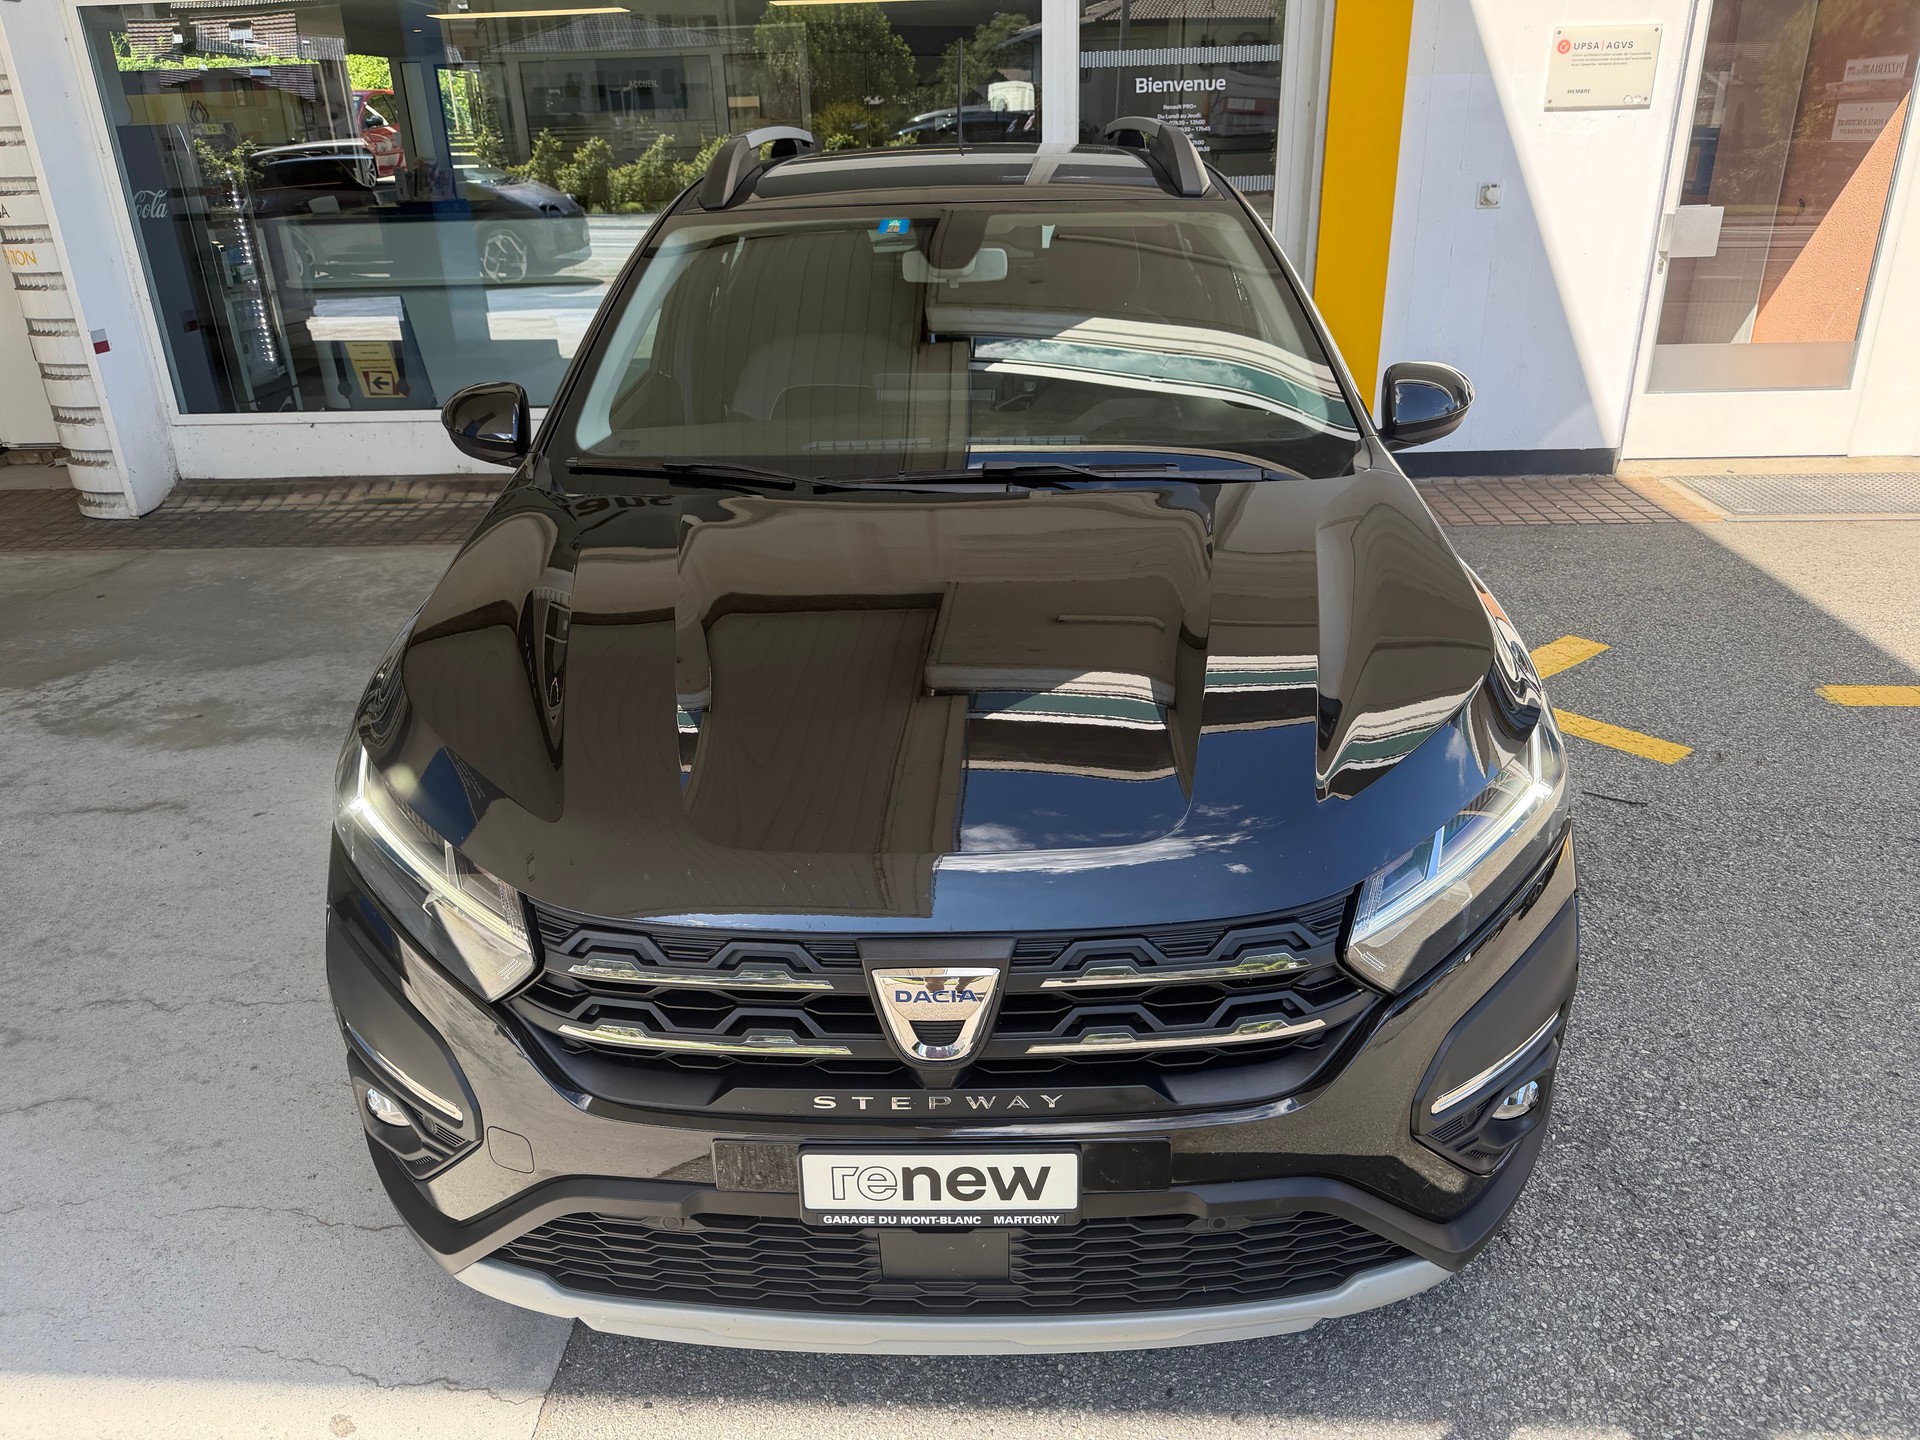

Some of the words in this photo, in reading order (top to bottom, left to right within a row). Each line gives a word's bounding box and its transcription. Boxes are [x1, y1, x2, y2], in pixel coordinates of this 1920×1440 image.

[1573, 42, 1599, 50] UPSA
[1606, 41, 1634, 49] AGVS
[629, 80, 659, 88] ACCUEIL
[1135, 77, 1226, 93] Bienvenue
[0, 203, 10, 219] A
[895, 989, 979, 1003] DACIA
[813, 1094, 1063, 1110] STEPWAY
[831, 1165, 1052, 1202] renew
[823, 1214, 875, 1226] GARAGE
[878, 1214, 897, 1226] DU
[900, 1214, 982, 1226] MONT-BLANC
[993, 1214, 1060, 1226] MARTIGNY
